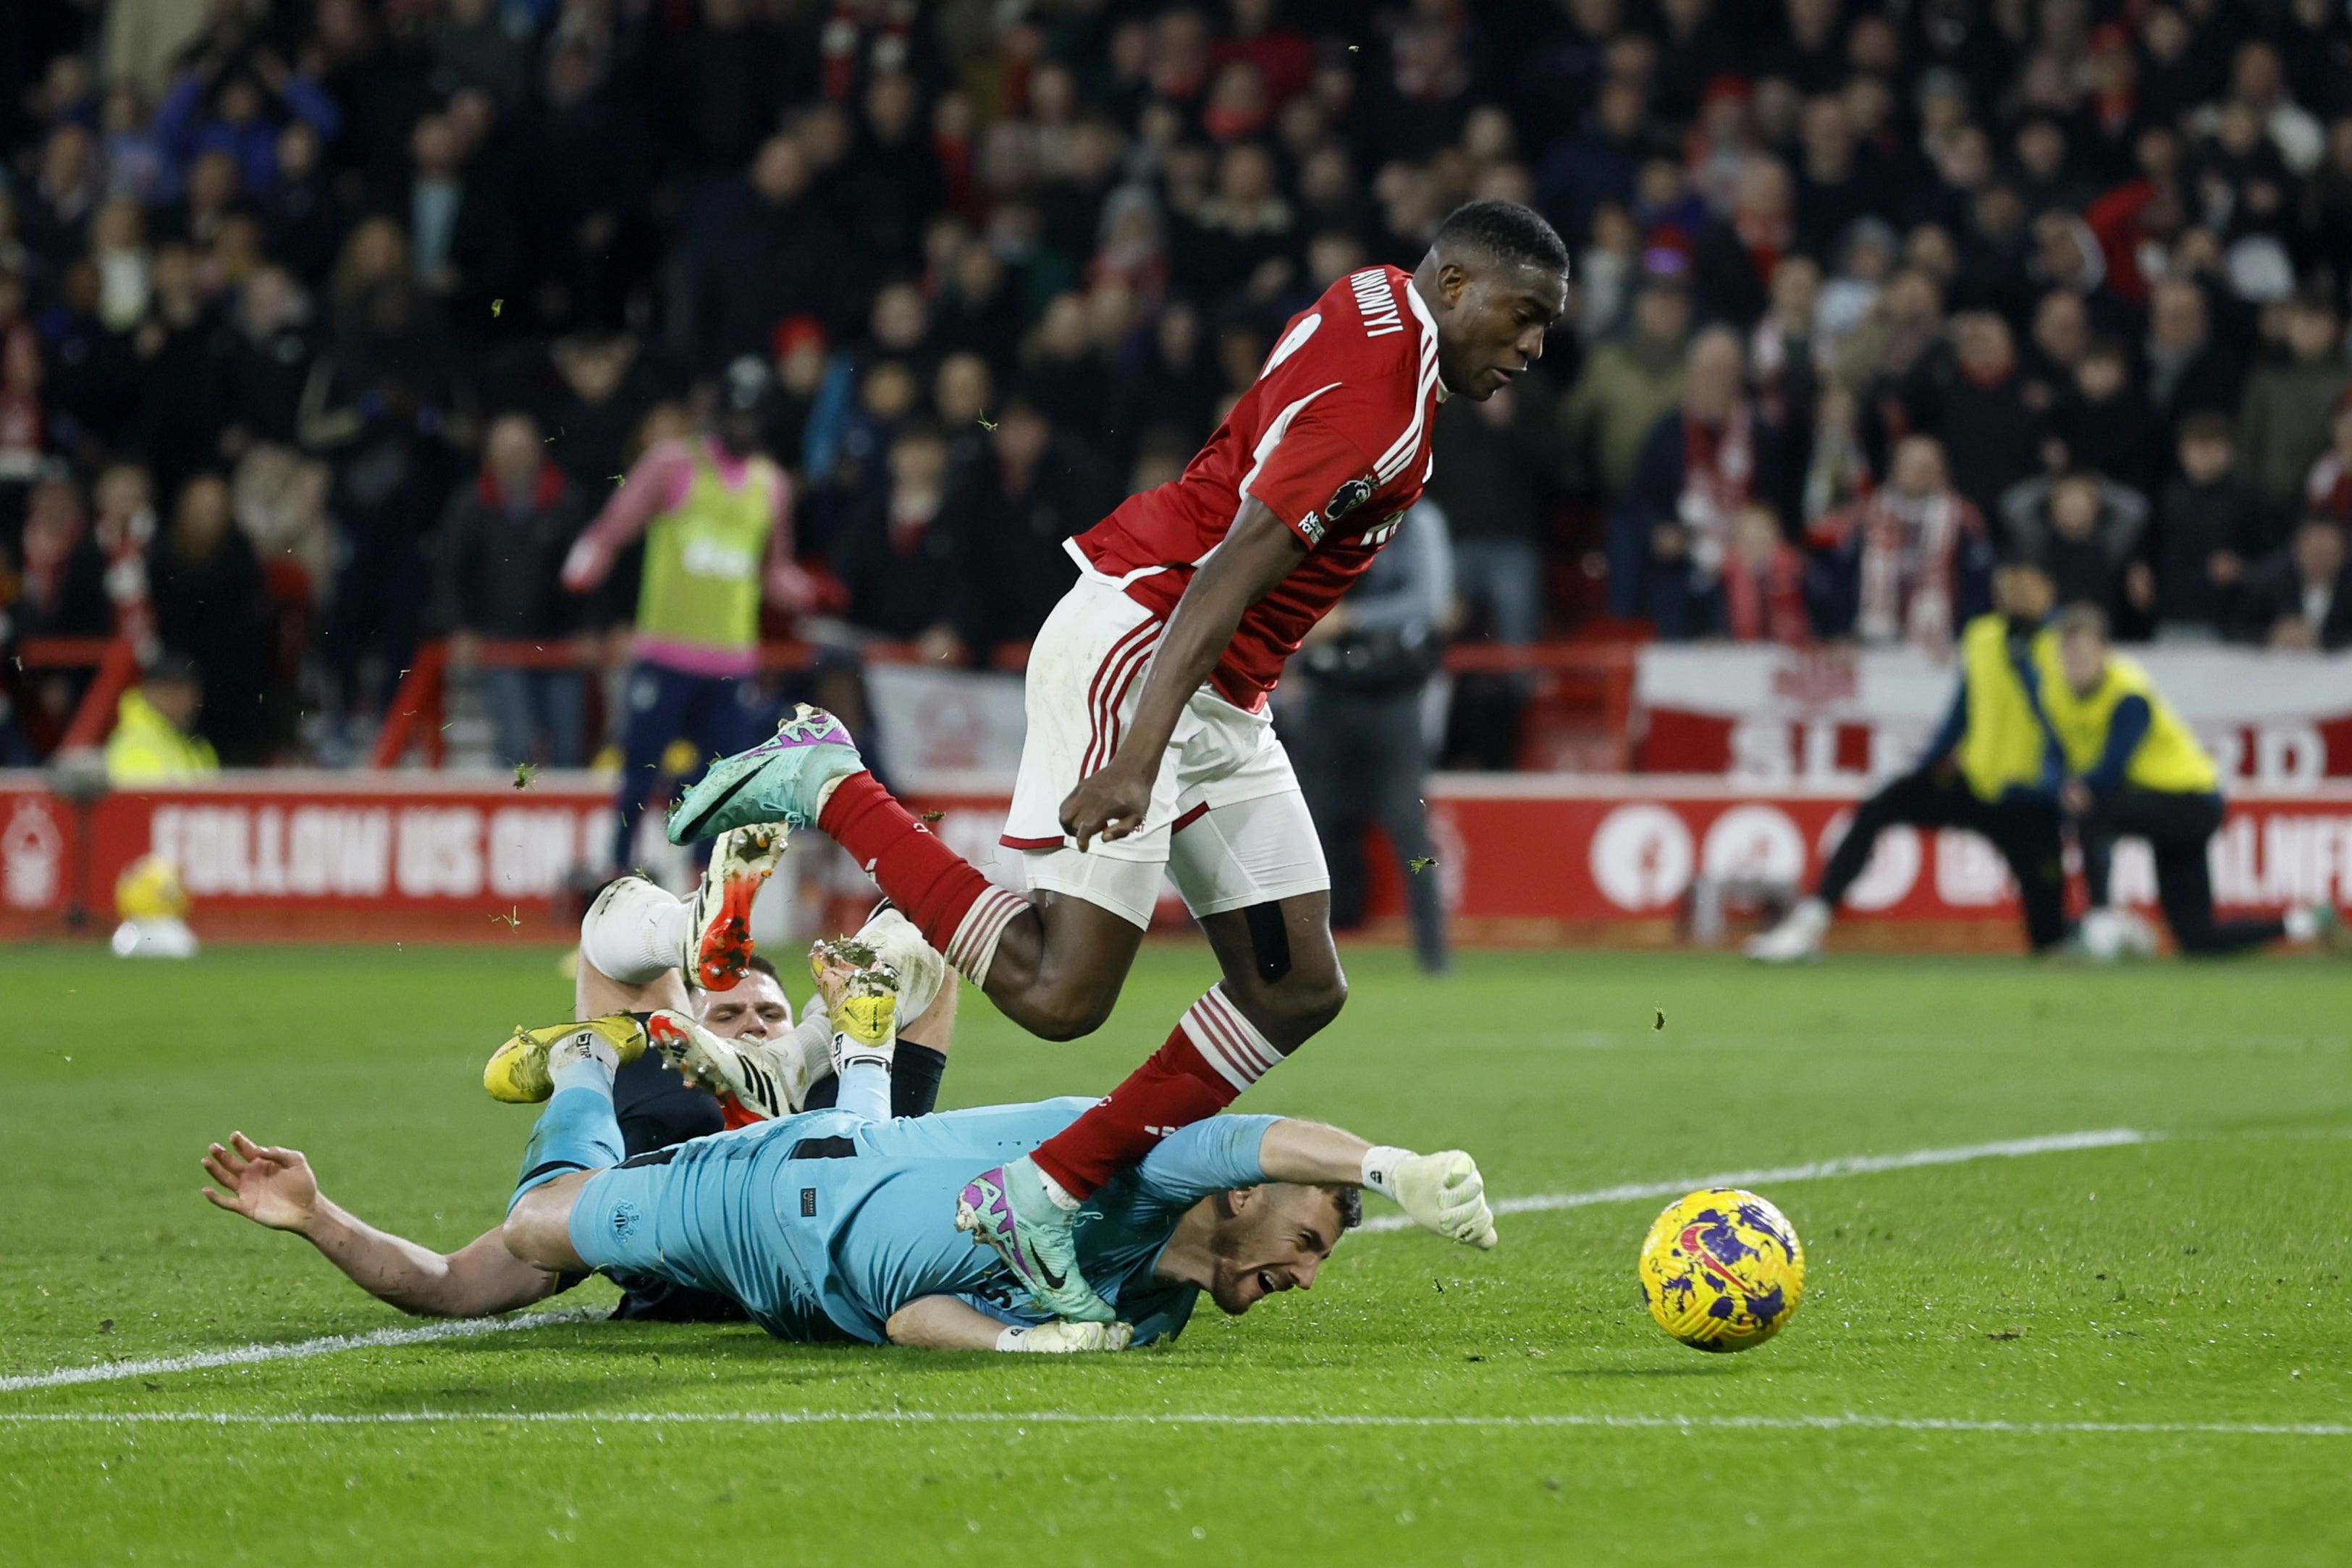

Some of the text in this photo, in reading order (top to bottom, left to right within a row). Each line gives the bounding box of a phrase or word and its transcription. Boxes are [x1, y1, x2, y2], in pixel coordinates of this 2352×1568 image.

[1349, 268, 1404, 337] AWONIYI
[151, 804, 388, 896] FOLLOW
[397, 804, 484, 898] US
